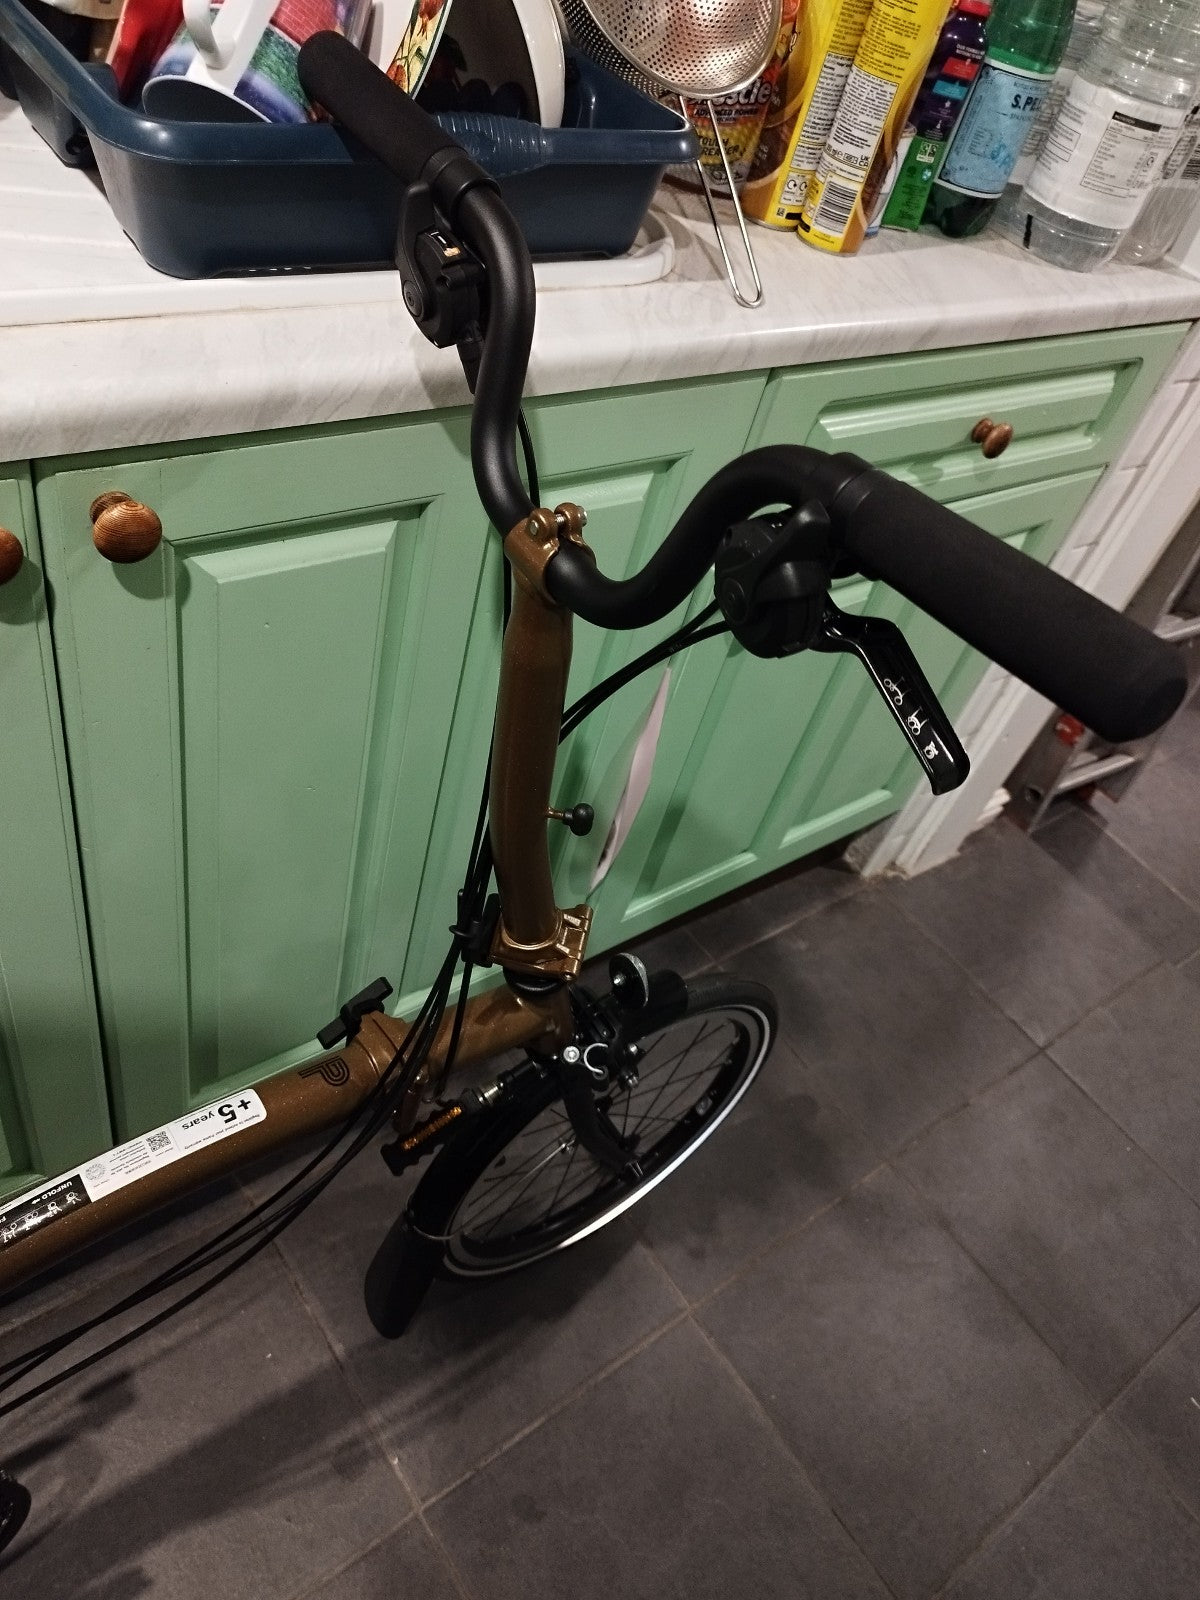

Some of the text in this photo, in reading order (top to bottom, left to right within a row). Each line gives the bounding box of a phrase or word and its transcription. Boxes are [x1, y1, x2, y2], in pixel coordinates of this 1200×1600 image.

[694, 108, 734, 118] ADVNCED
[180, 1110, 215, 1130] years
[41, 1181, 72, 1199] UNFOLD
